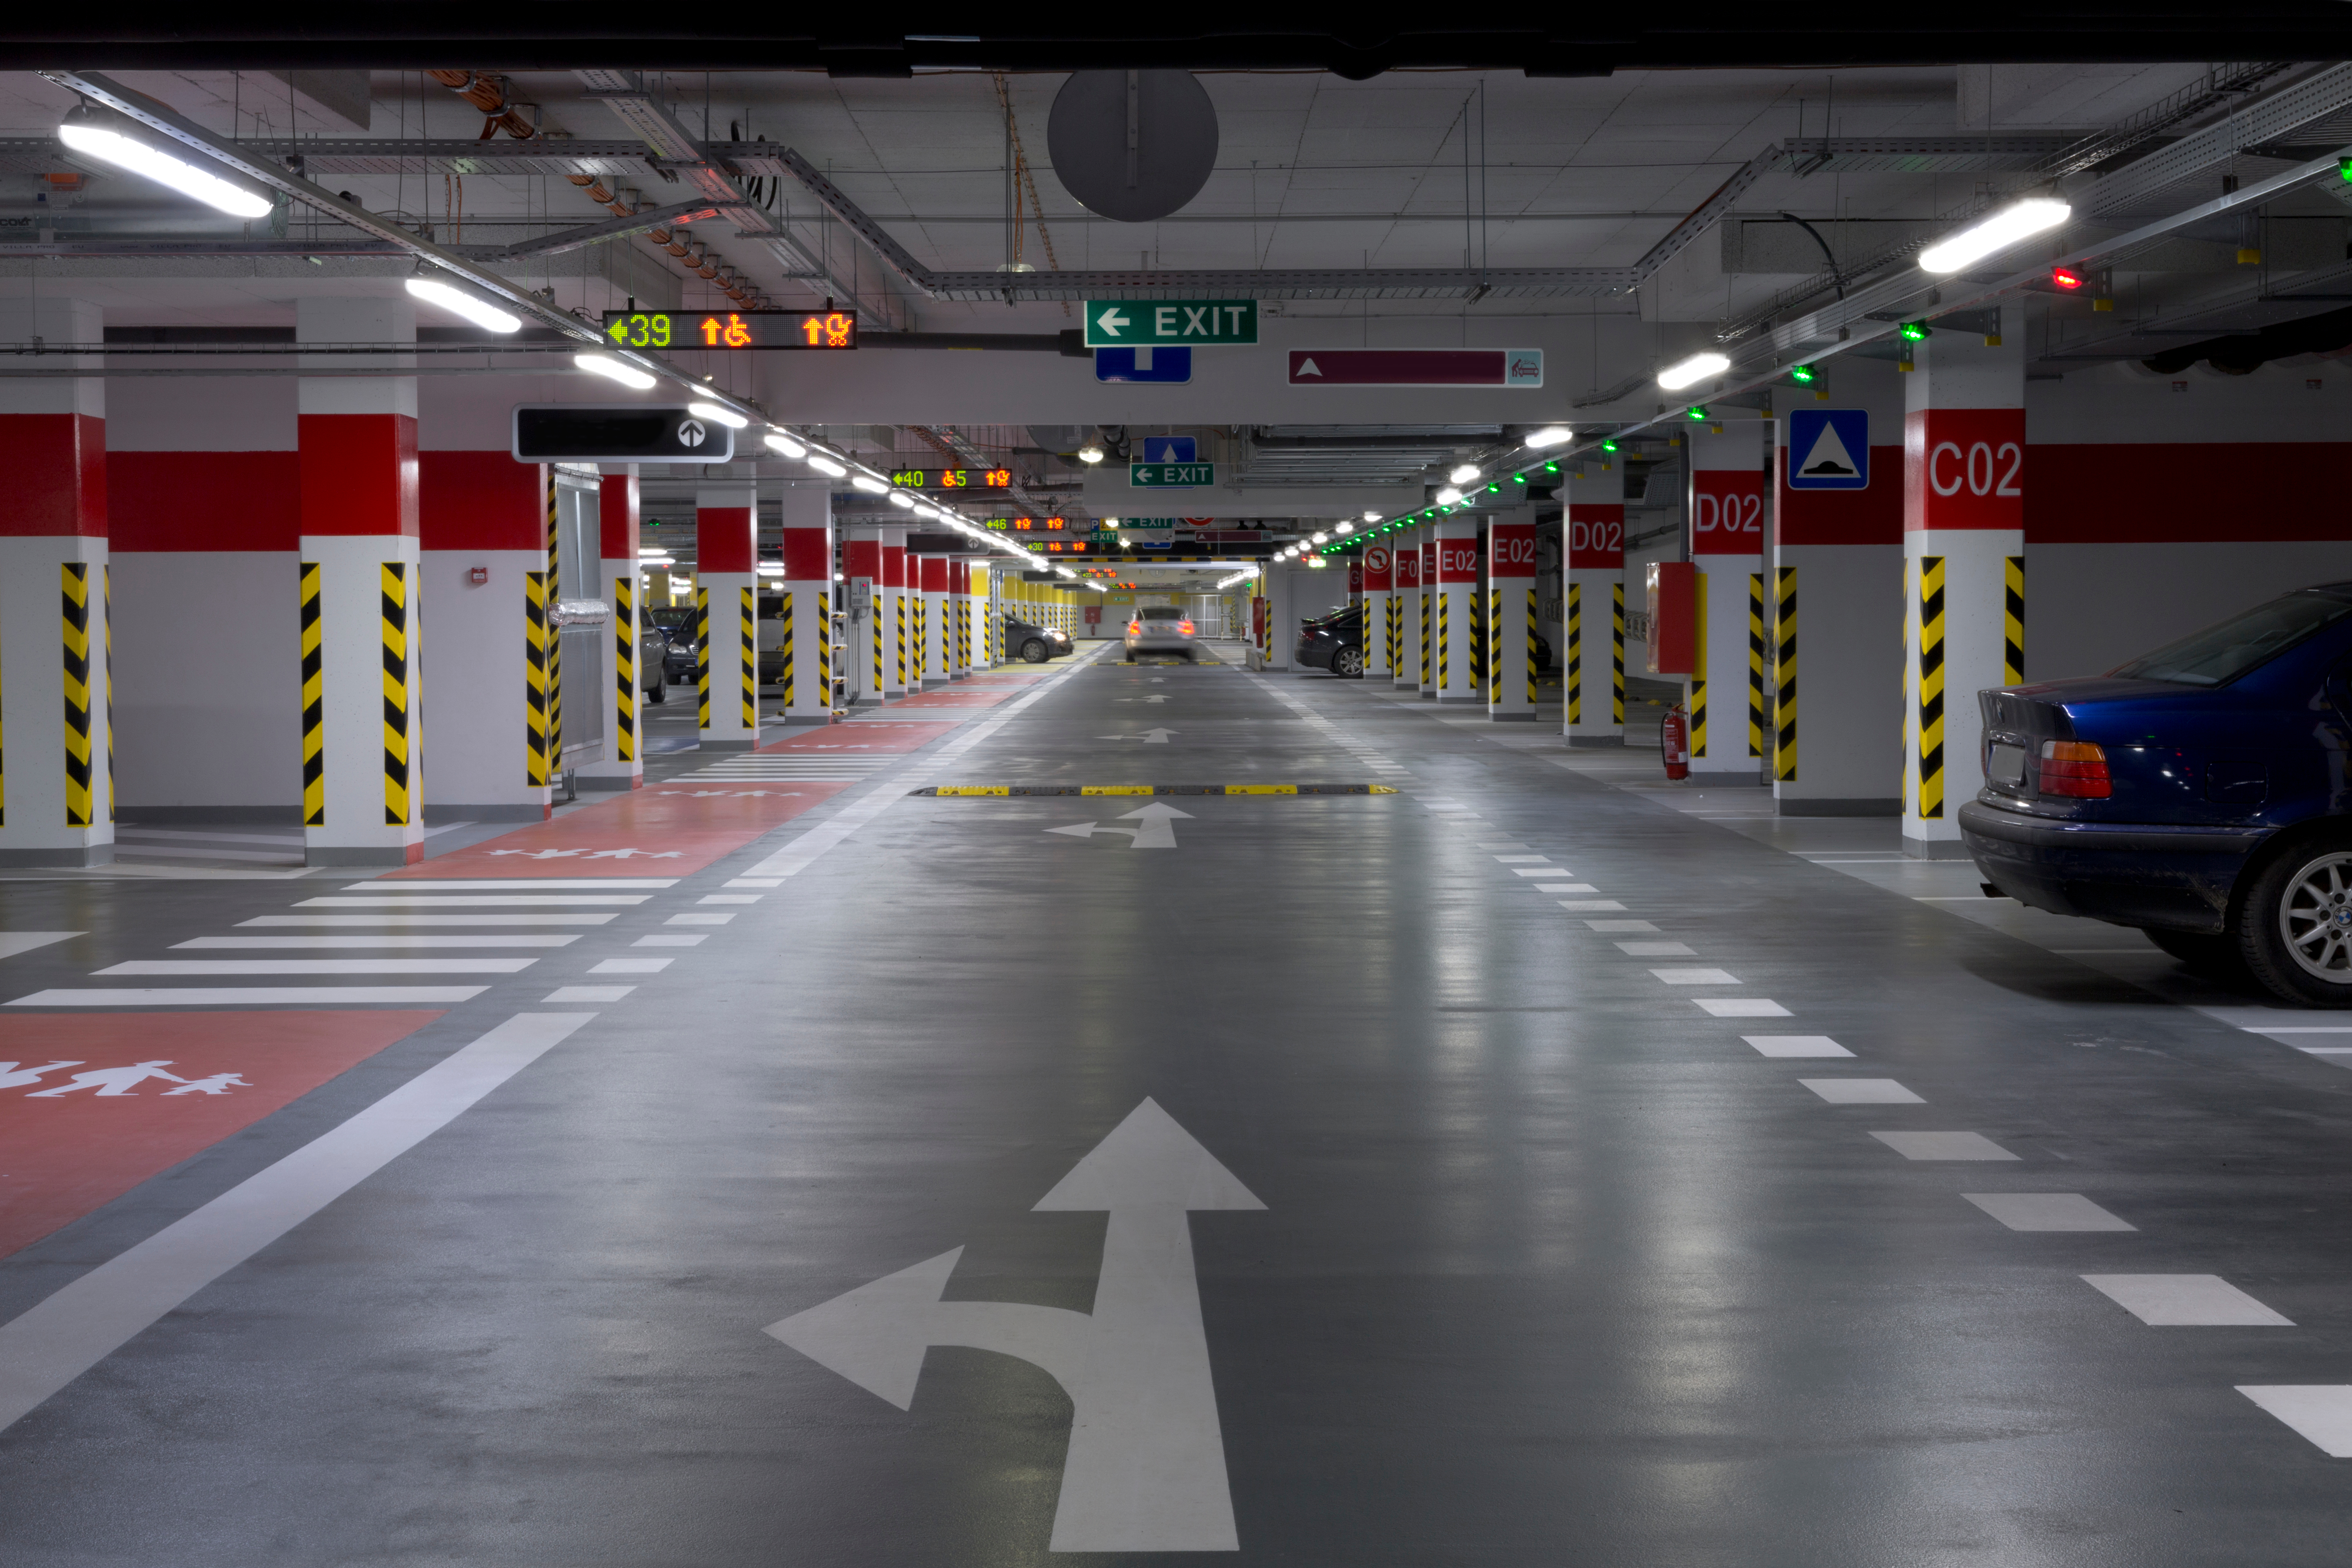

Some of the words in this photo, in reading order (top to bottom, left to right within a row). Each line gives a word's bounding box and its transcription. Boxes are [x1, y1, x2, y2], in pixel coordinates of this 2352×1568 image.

[630, 314, 670, 347] 39
[1155, 307, 1247, 336] EXIT
[904, 470, 923, 487] 40
[956, 470, 967, 487] 5
[1164, 467, 1209, 482] EXIT
[1929, 441, 2021, 497] C02
[1140, 518, 1169, 526] EXIT
[1696, 493, 1761, 532] D02
[993, 519, 1007, 530] 46
[1091, 520, 1099, 529] P
[1571, 521, 1622, 552] D02
[1033, 542, 1043, 551] 30
[1494, 539, 1535, 563] E02
[1398, 560, 1419, 577] F0
[1442, 550, 1477, 571] E02
